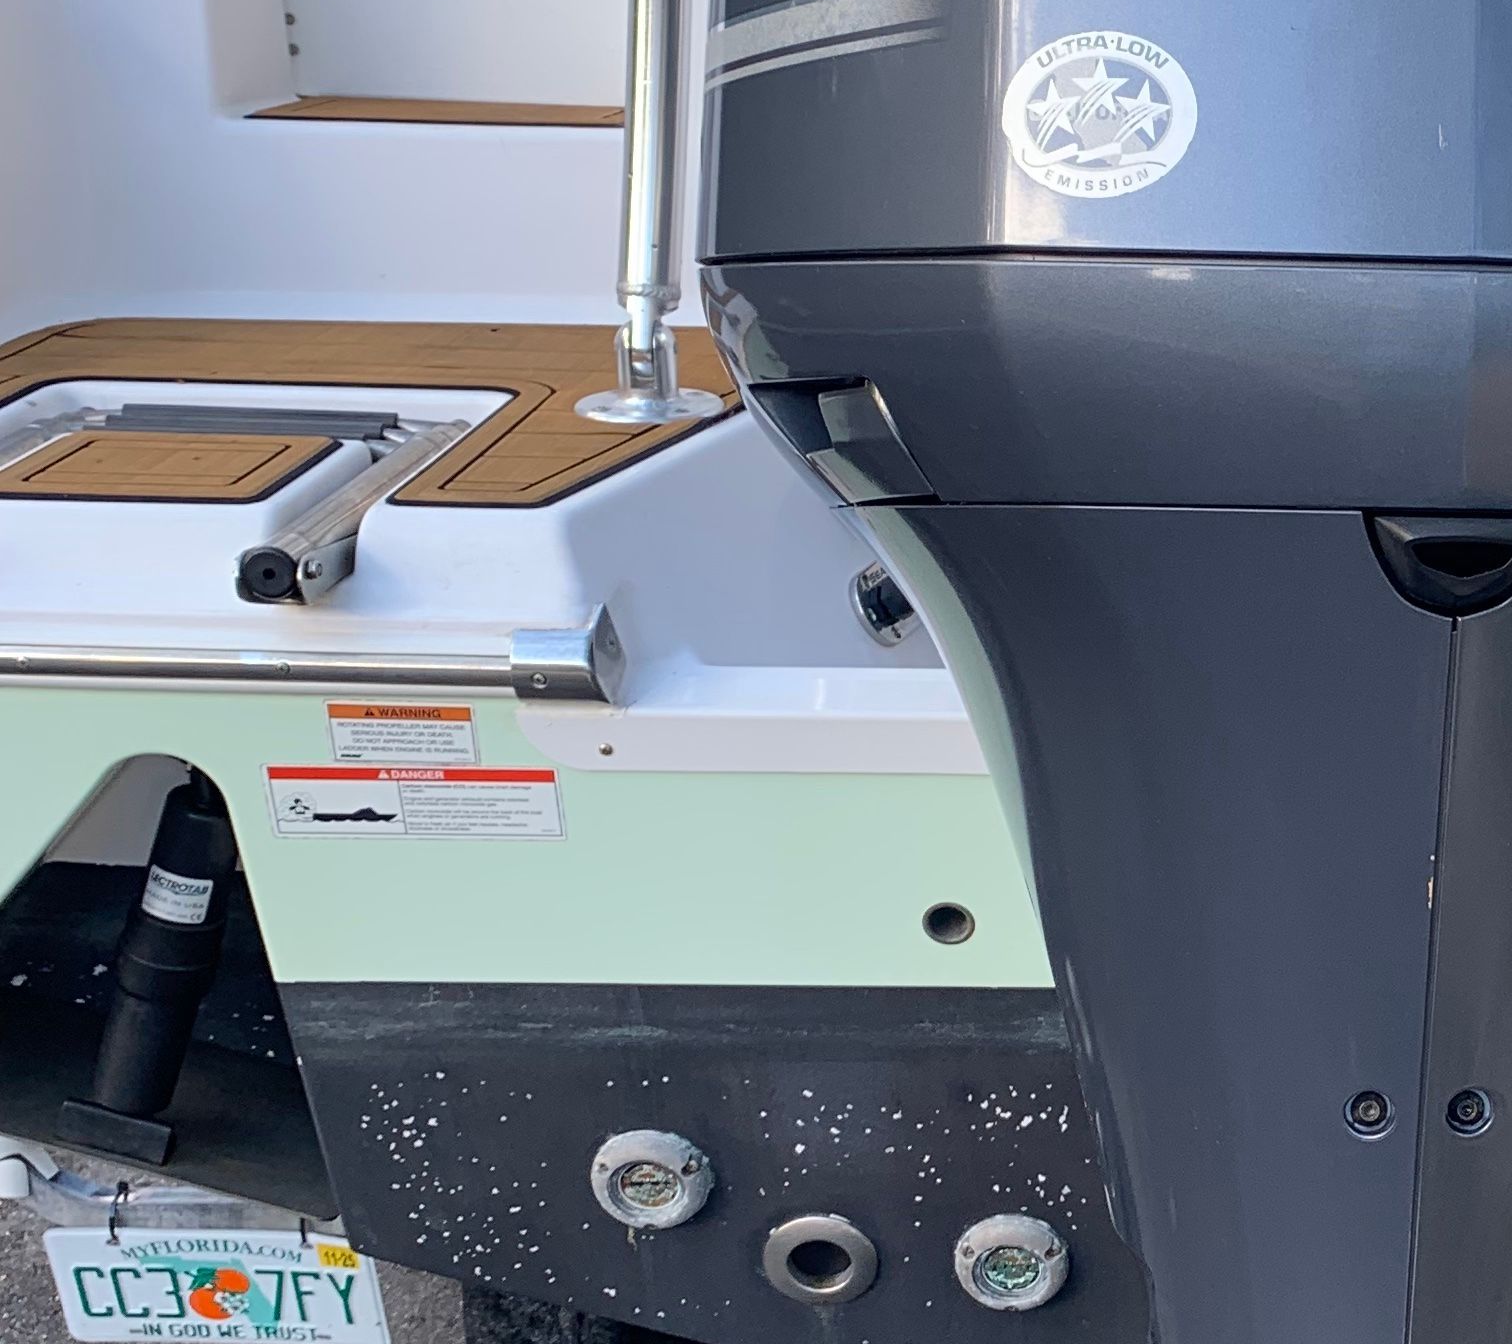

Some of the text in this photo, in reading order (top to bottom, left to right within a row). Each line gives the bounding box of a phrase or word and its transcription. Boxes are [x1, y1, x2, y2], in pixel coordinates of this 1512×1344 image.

[1044, 169, 1150, 191] EMISSION
[378, 708, 441, 719] WARNING
[391, 769, 445, 780] DANGER
[120, 1239, 302, 1263] MYFLORIDA.COM
[72, 1266, 355, 1325] CC3 7FY
[143, 1323, 318, 1341] IN GOD WE TRUST
